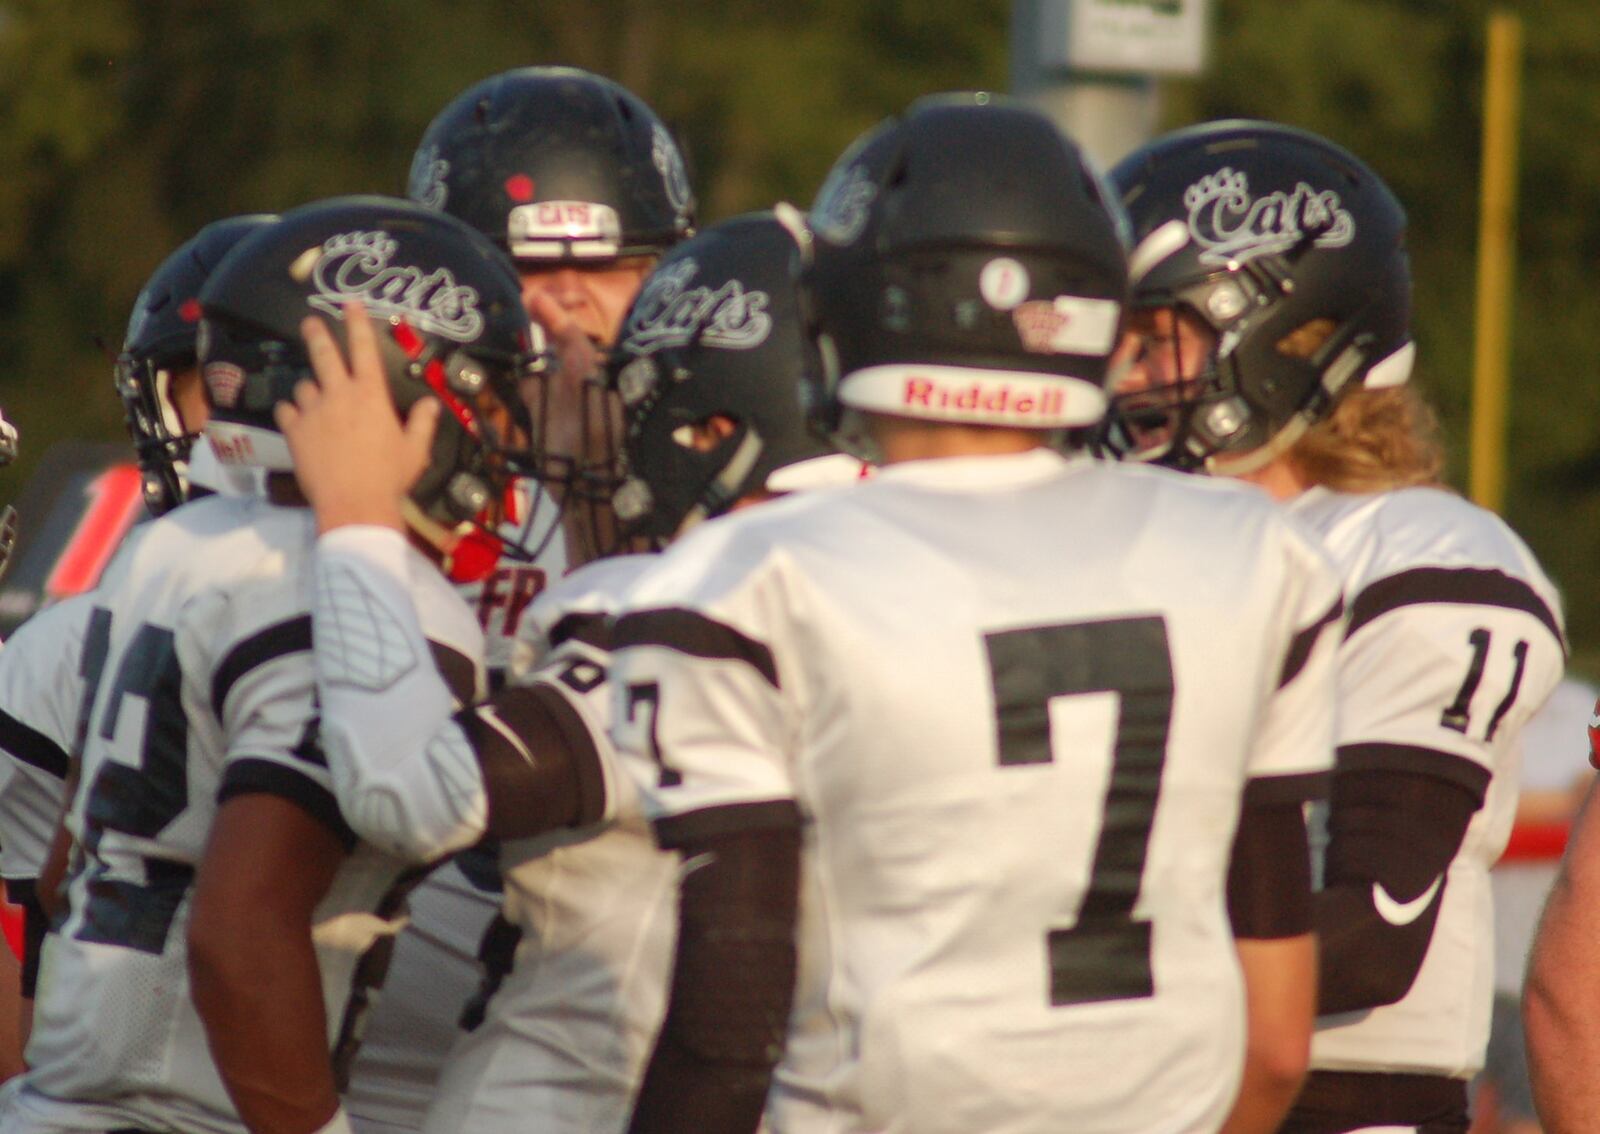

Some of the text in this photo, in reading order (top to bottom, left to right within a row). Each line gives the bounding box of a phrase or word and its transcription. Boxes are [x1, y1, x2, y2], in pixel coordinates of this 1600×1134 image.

[1184, 166, 1356, 264] Cats
[307, 230, 486, 343] Cats
[622, 257, 772, 352] Cats
[903, 376, 1064, 417] Riddell
[623, 681, 684, 788] 7
[1439, 627, 1531, 743] 11
[982, 614, 1175, 1006] 7
